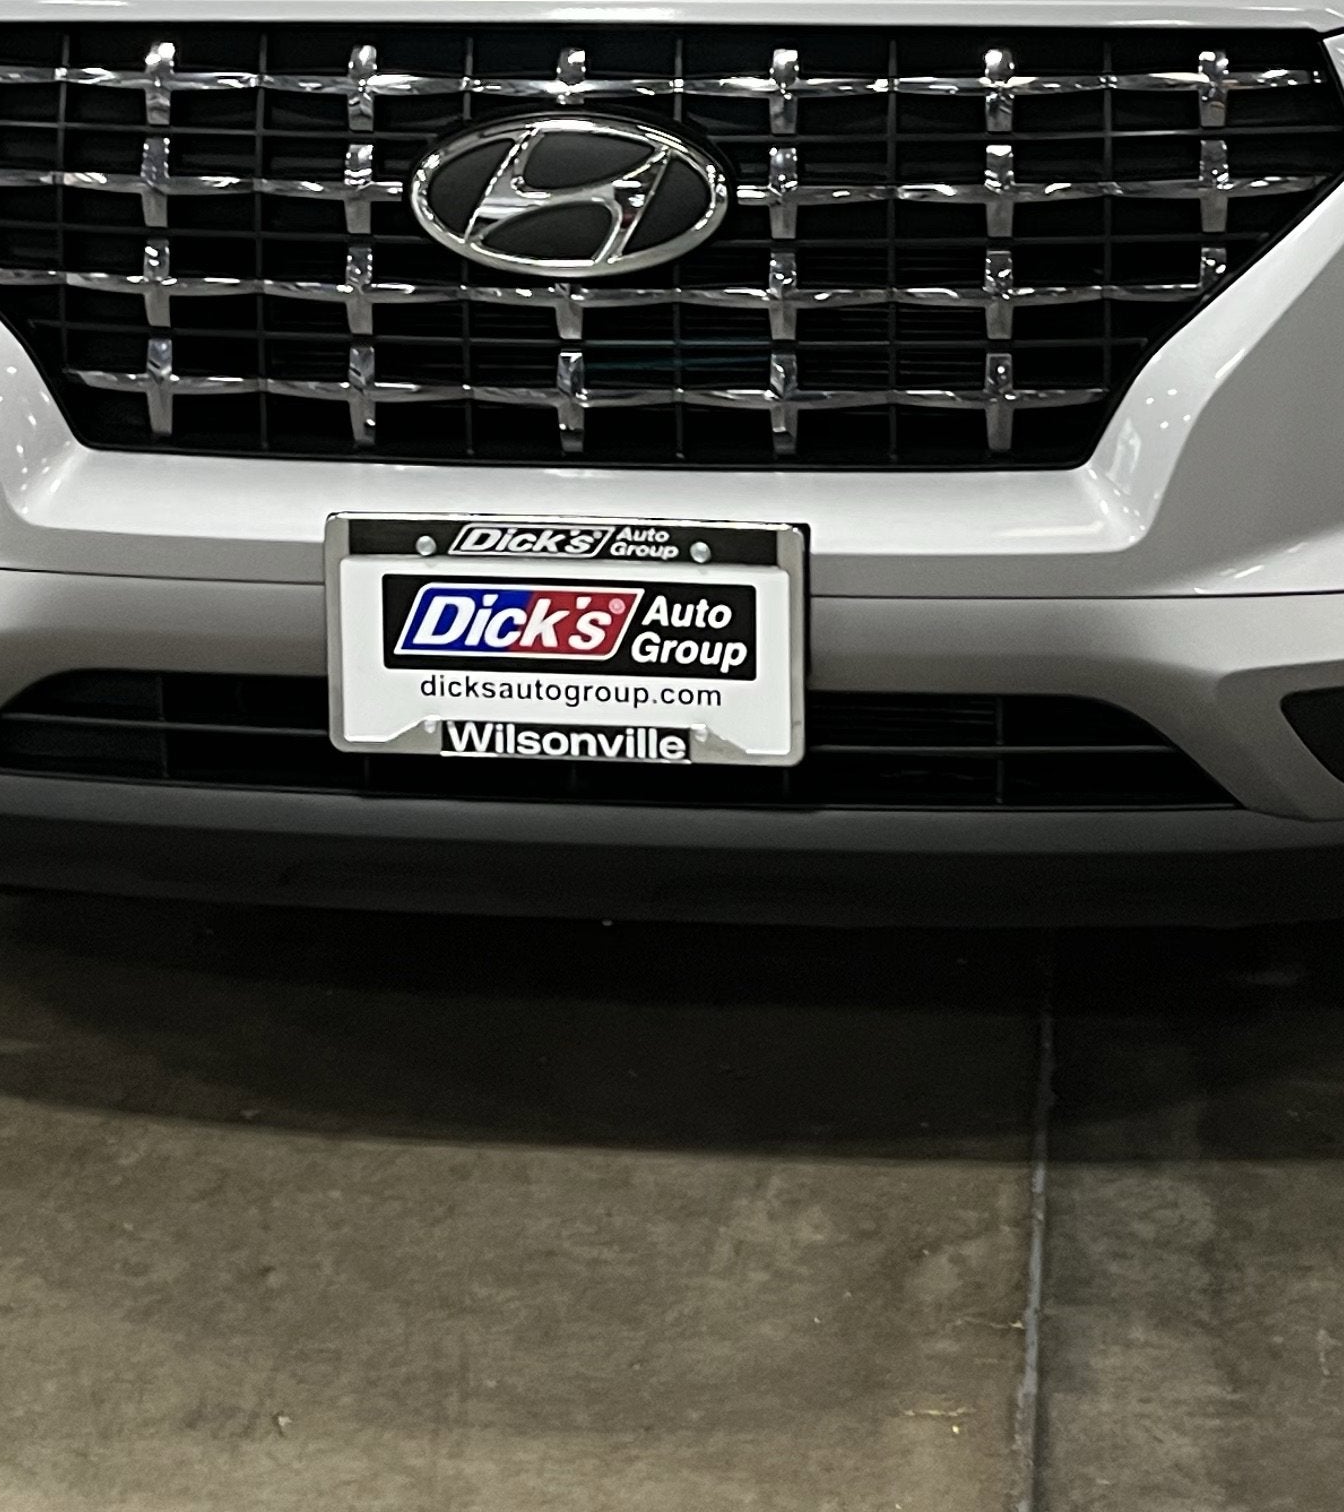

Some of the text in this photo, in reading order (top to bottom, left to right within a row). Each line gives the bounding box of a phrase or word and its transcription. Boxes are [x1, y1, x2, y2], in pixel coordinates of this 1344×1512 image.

[459, 526, 670, 554] Dick's Auto
[609, 541, 680, 561] Group
[412, 593, 733, 651] Dick's Auto
[630, 631, 748, 674] Group
[420, 674, 723, 709] dicksautogroup.com
[446, 720, 688, 761] Wilsonville
